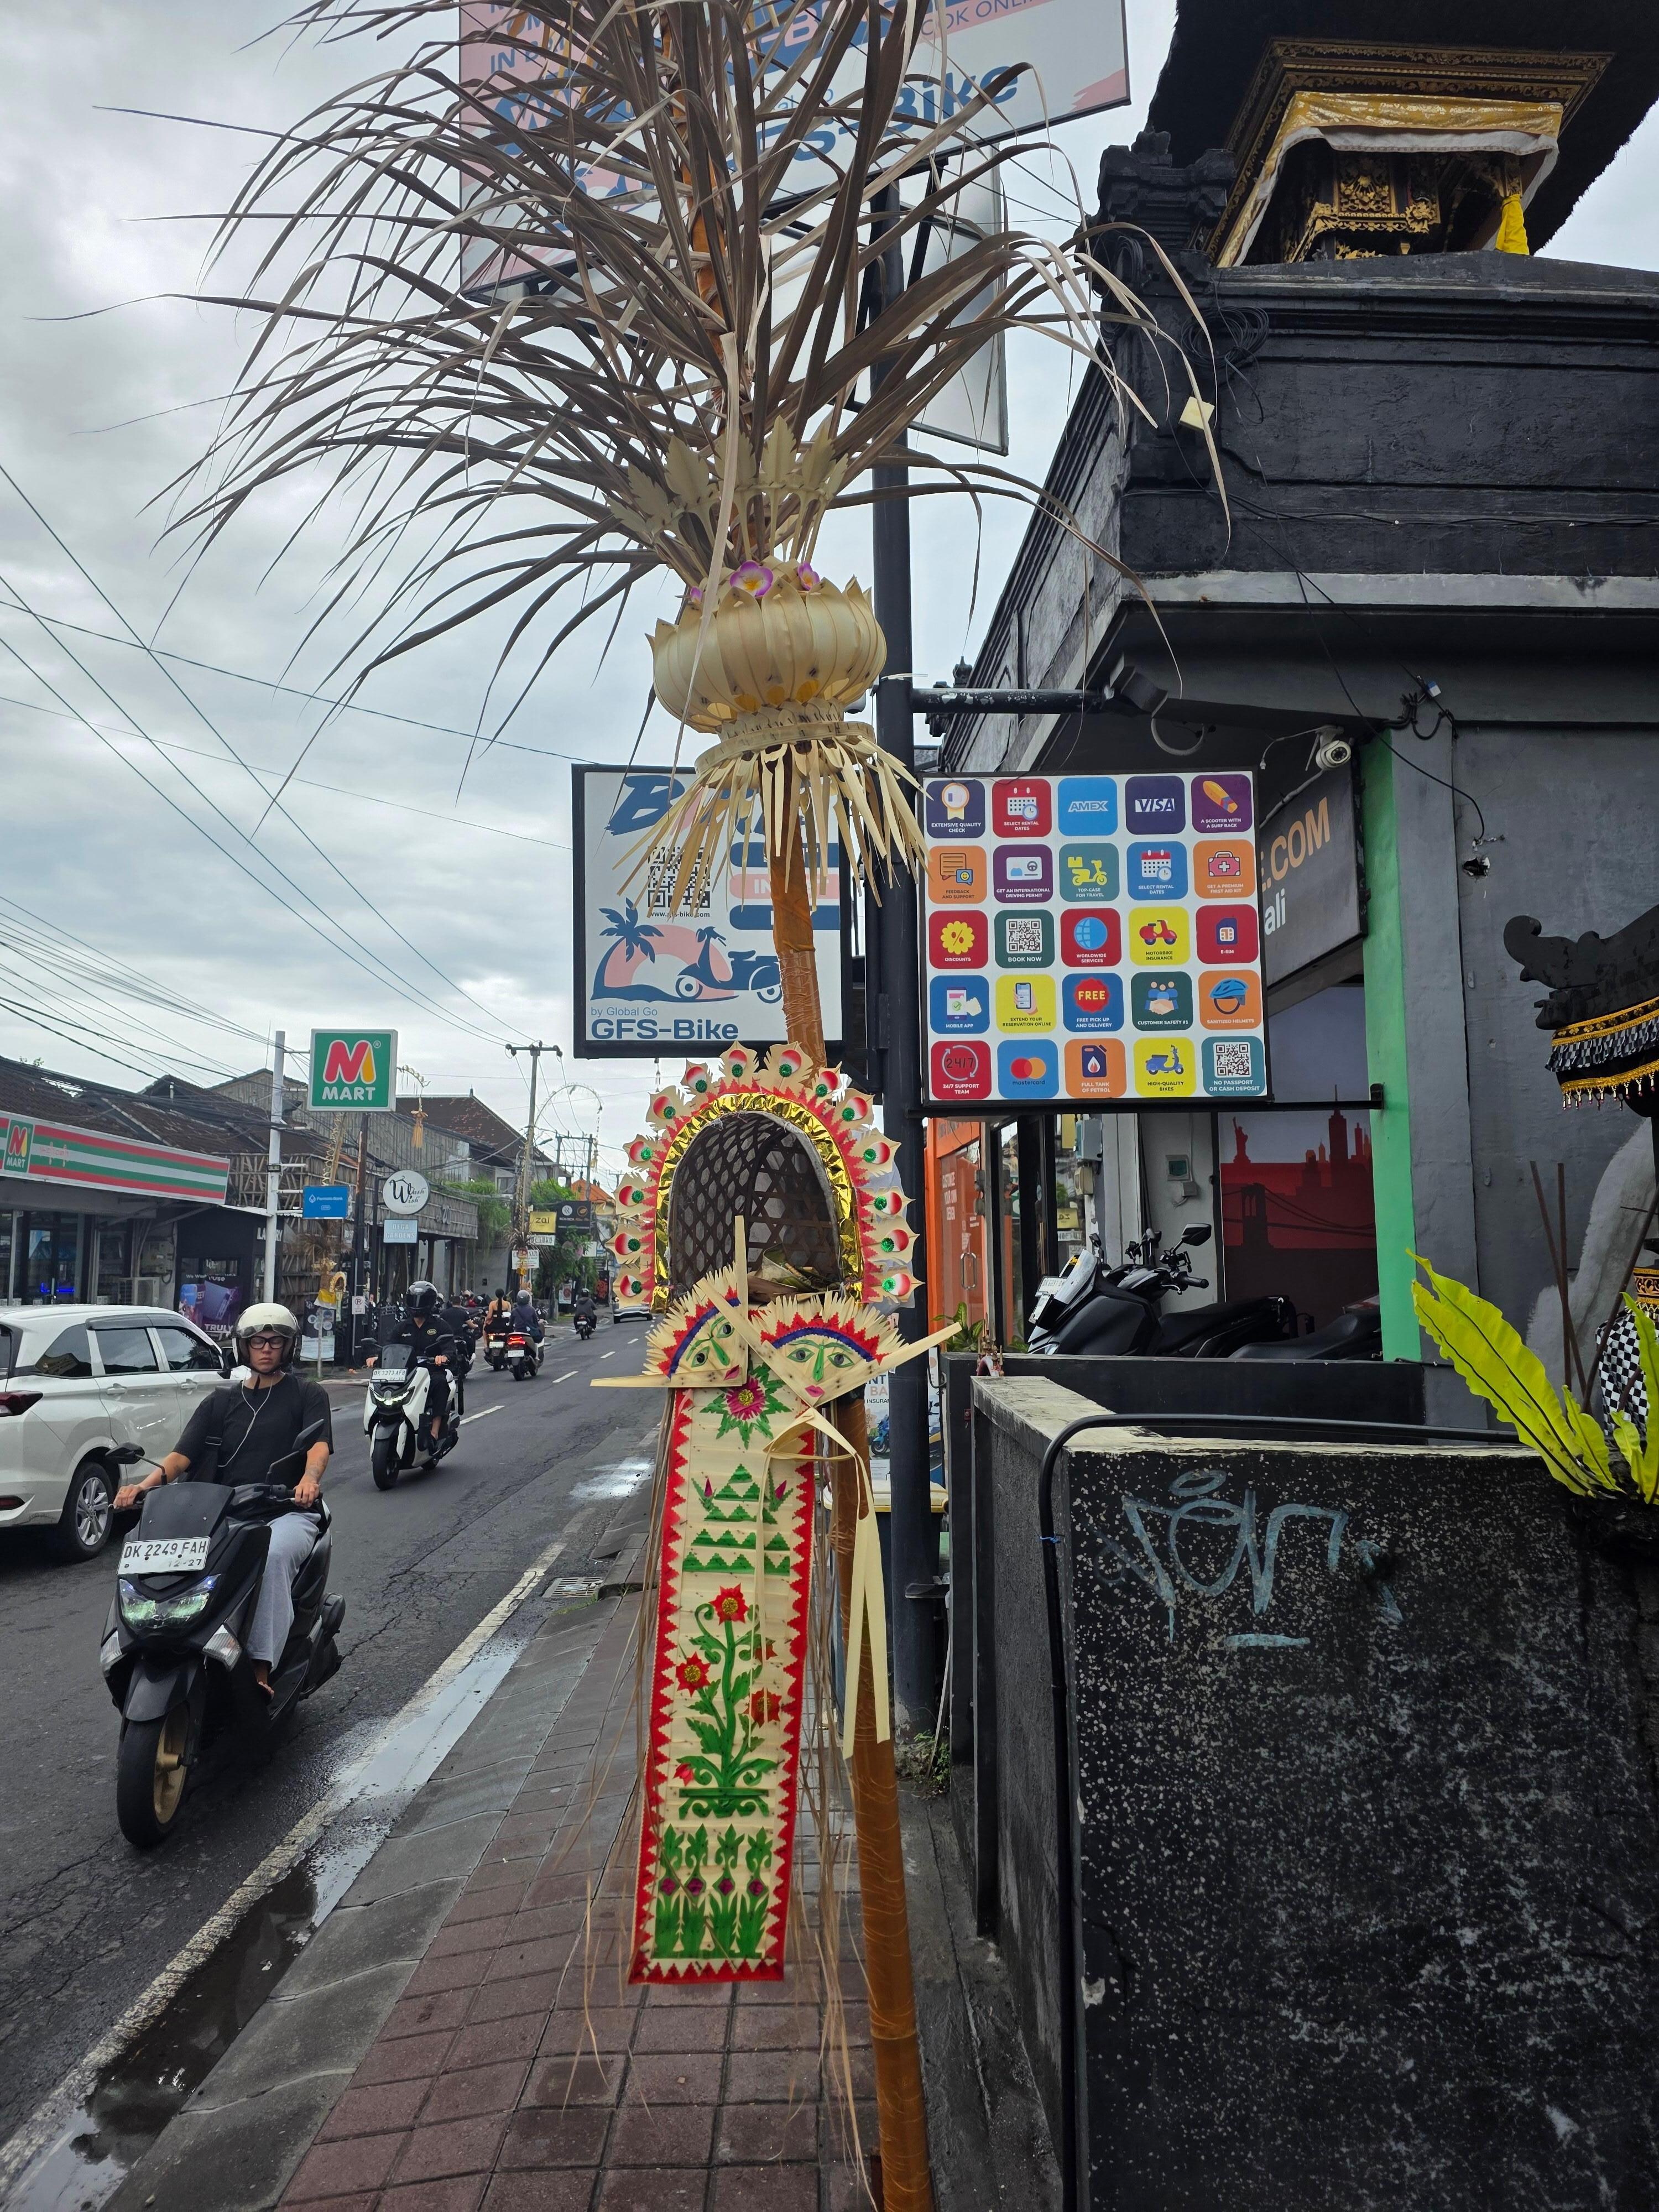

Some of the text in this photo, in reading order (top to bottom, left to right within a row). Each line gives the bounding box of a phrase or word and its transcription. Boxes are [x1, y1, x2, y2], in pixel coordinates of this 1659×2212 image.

[1068, 801, 1108, 812] AMEX
[1137, 799, 1175, 812] VISA
[1078, 990, 1105, 1000] FREE
[591, 1006, 658, 1018] by Global Go
[591, 1019, 739, 1040] GFS-Bike
[946, 1058, 974, 1068] 24/7
[322, 1087, 375, 1100] MART
[6, 1156, 25, 1168] MART
[124, 1541, 207, 1558] DK 2249 FAH
